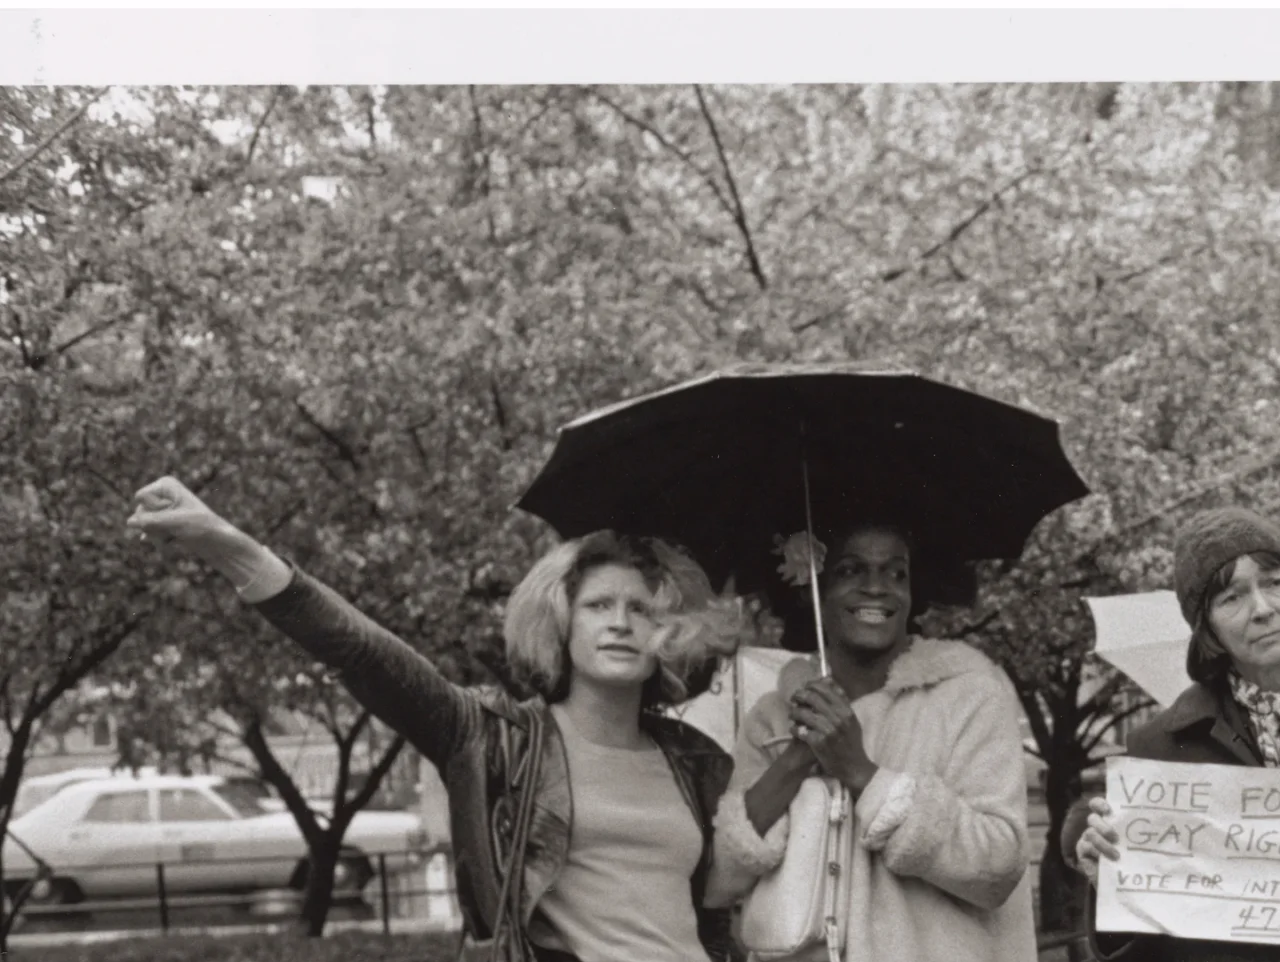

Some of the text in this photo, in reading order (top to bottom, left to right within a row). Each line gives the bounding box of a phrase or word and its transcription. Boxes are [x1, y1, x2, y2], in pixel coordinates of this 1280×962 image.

[1119, 775, 1212, 809] VOTE
[1125, 818, 1206, 853] GAY
[1117, 870, 1172, 891] VOTE
[1185, 873, 1223, 891] FOR
